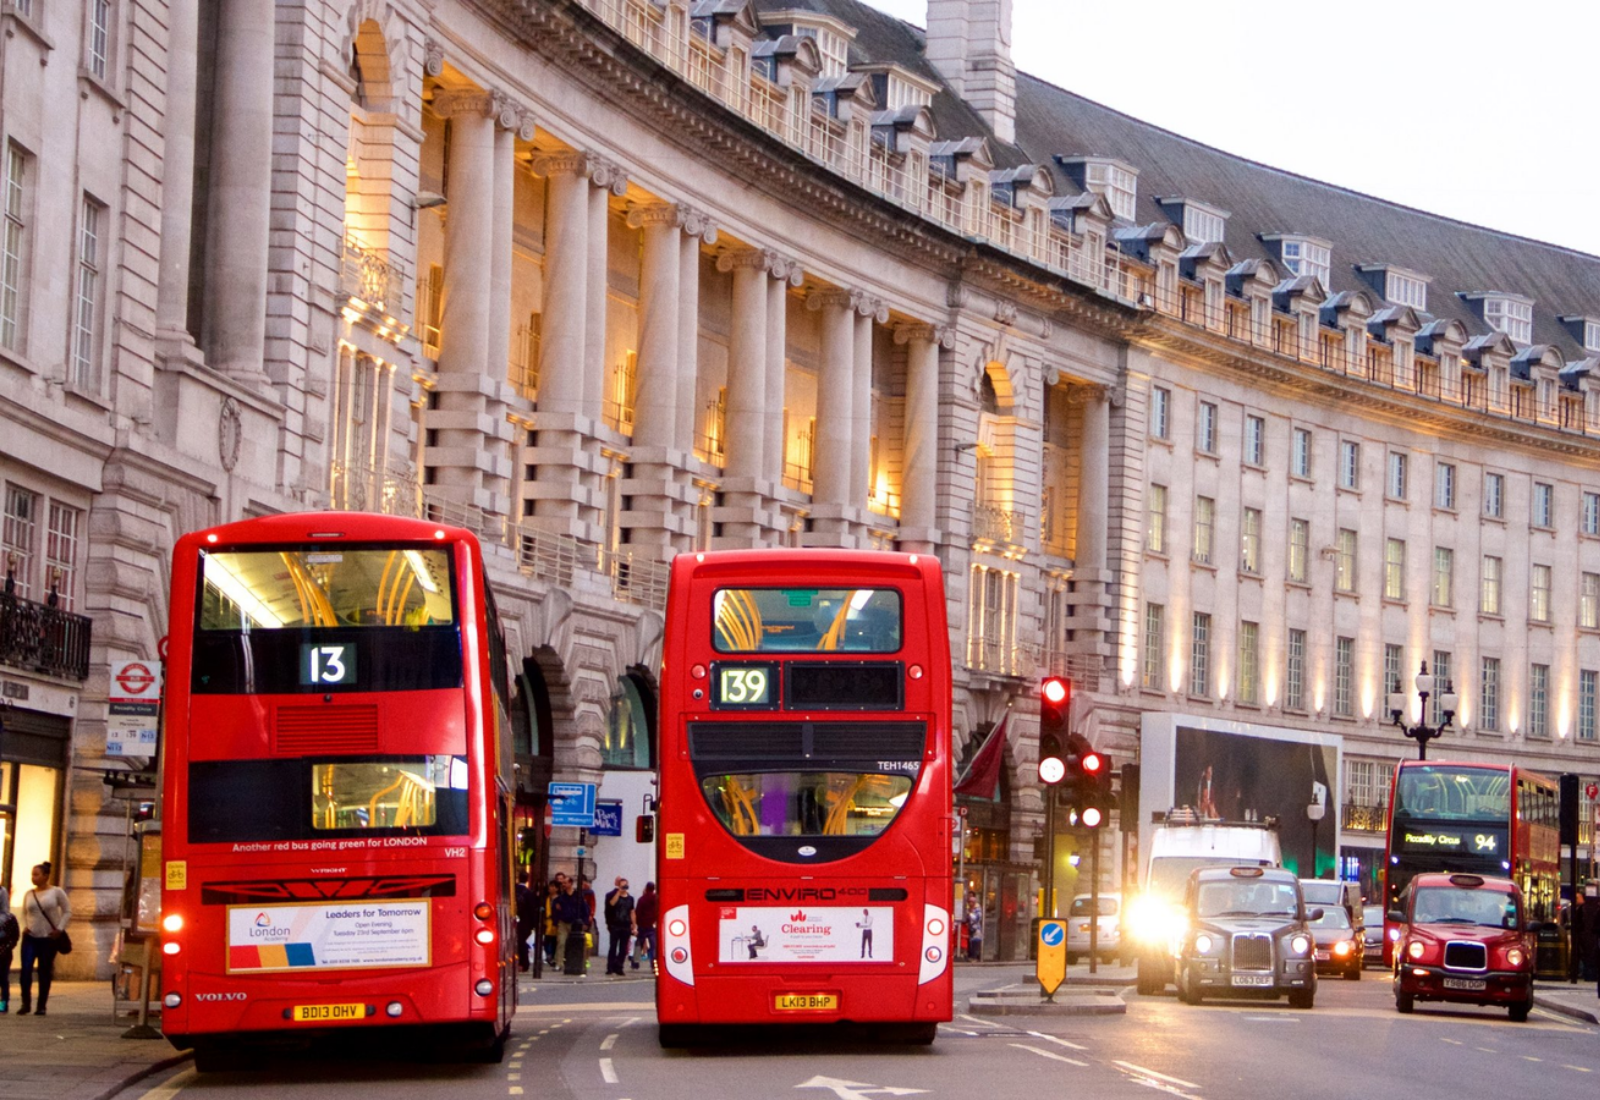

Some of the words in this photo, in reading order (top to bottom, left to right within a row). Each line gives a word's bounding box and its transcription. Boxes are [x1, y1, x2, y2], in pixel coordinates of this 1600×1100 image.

[311, 646, 345, 682] 13
[721, 670, 766, 702] 139
[878, 761, 920, 770] TEH1465
[1588, 786, 1595, 796] F
[232, 843, 272, 852] Another
[274, 842, 290, 850] red
[292, 841, 309, 850] bus
[311, 840, 337, 850] going
[339, 840, 365, 850] green
[368, 838, 382, 847] for
[384, 837, 428, 847] LONDON
[1438, 834, 1460, 845] Circus
[1475, 834, 1496, 850] 94
[444, 847, 465, 857] VH2
[326, 910, 361, 919] Leaders
[363, 909, 375, 917] for
[378, 908, 421, 917] Tomorrow
[249, 926, 290, 937] London
[781, 923, 832, 936] Clearing
[195, 992, 247, 1001] VOLVO
[782, 997, 806, 1008] LK13
[809, 997, 831, 1007] BHP
[302, 1006, 330, 1018] BD13
[333, 1005, 357, 1017] OHV
